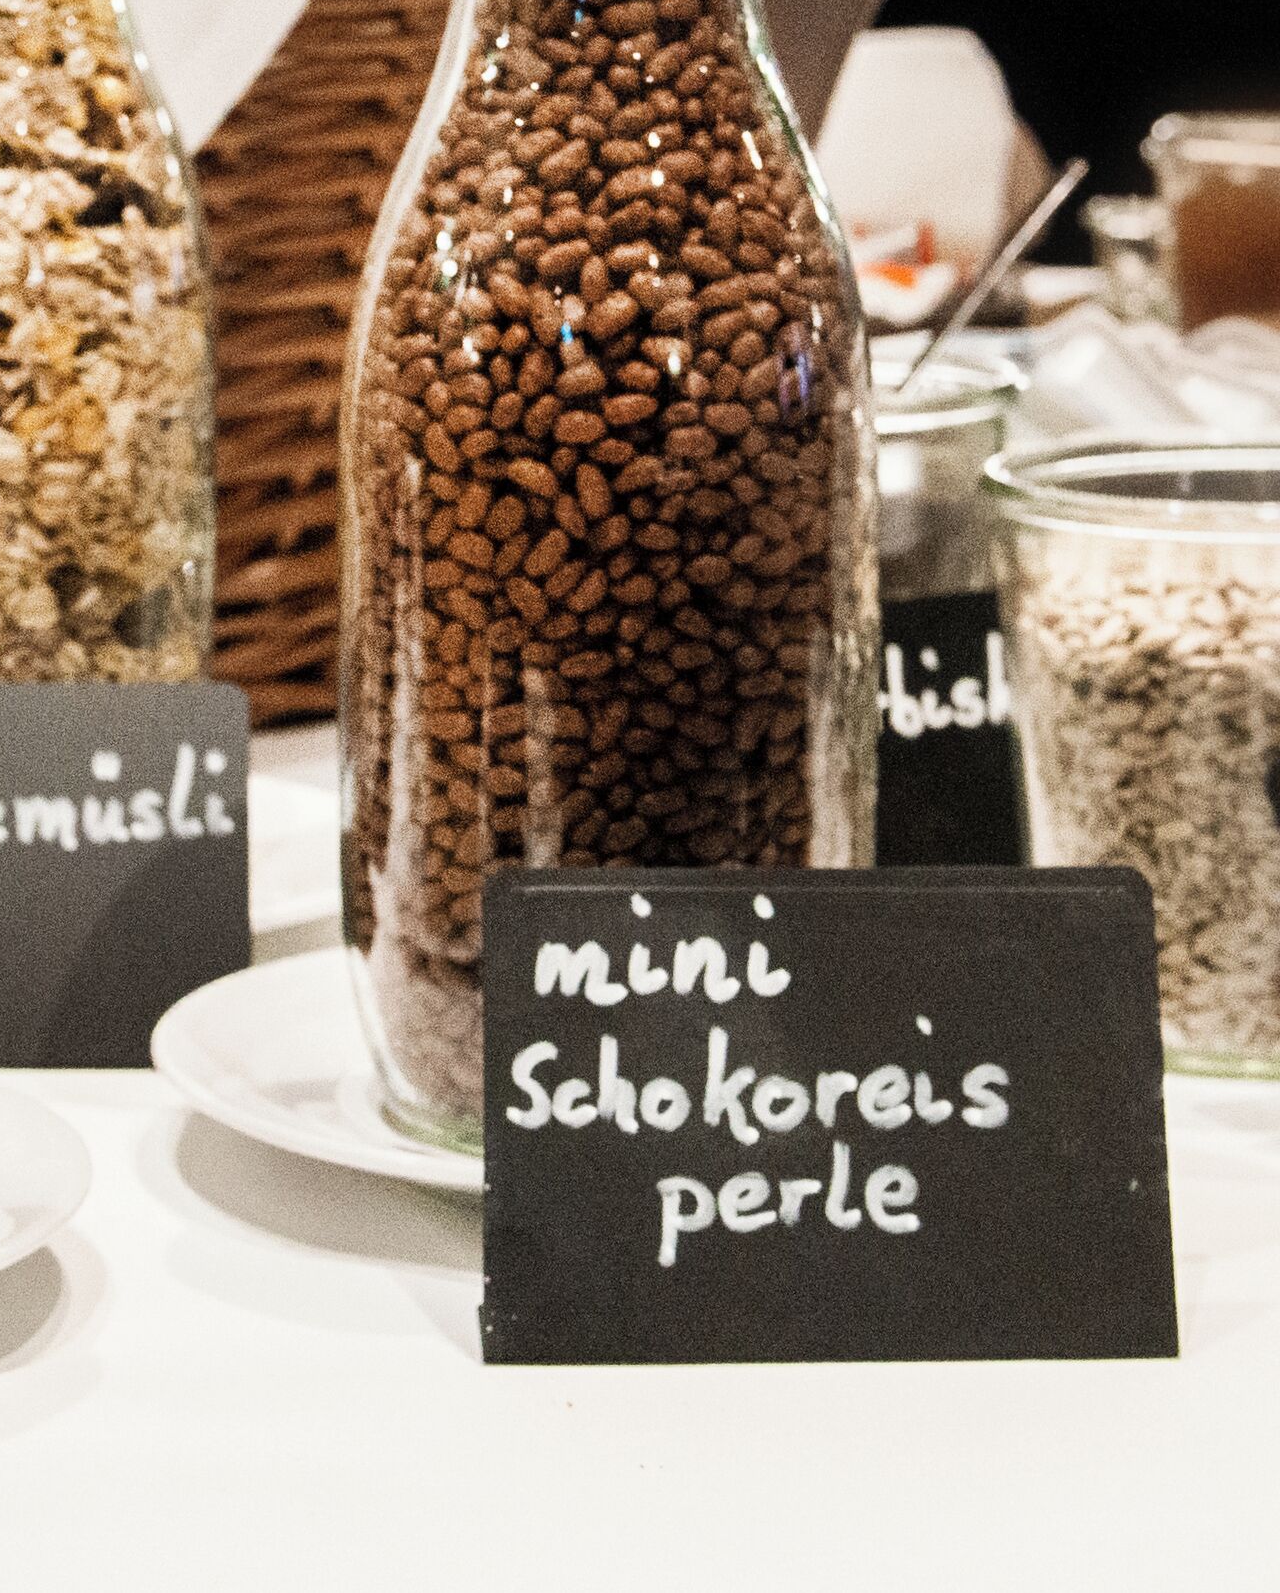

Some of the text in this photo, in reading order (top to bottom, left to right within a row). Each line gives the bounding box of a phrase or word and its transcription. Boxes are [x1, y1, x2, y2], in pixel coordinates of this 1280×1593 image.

[534, 893, 791, 1007] mini
[506, 1015, 1010, 1144] Schokoreis
[657, 1141, 921, 1267] perle
